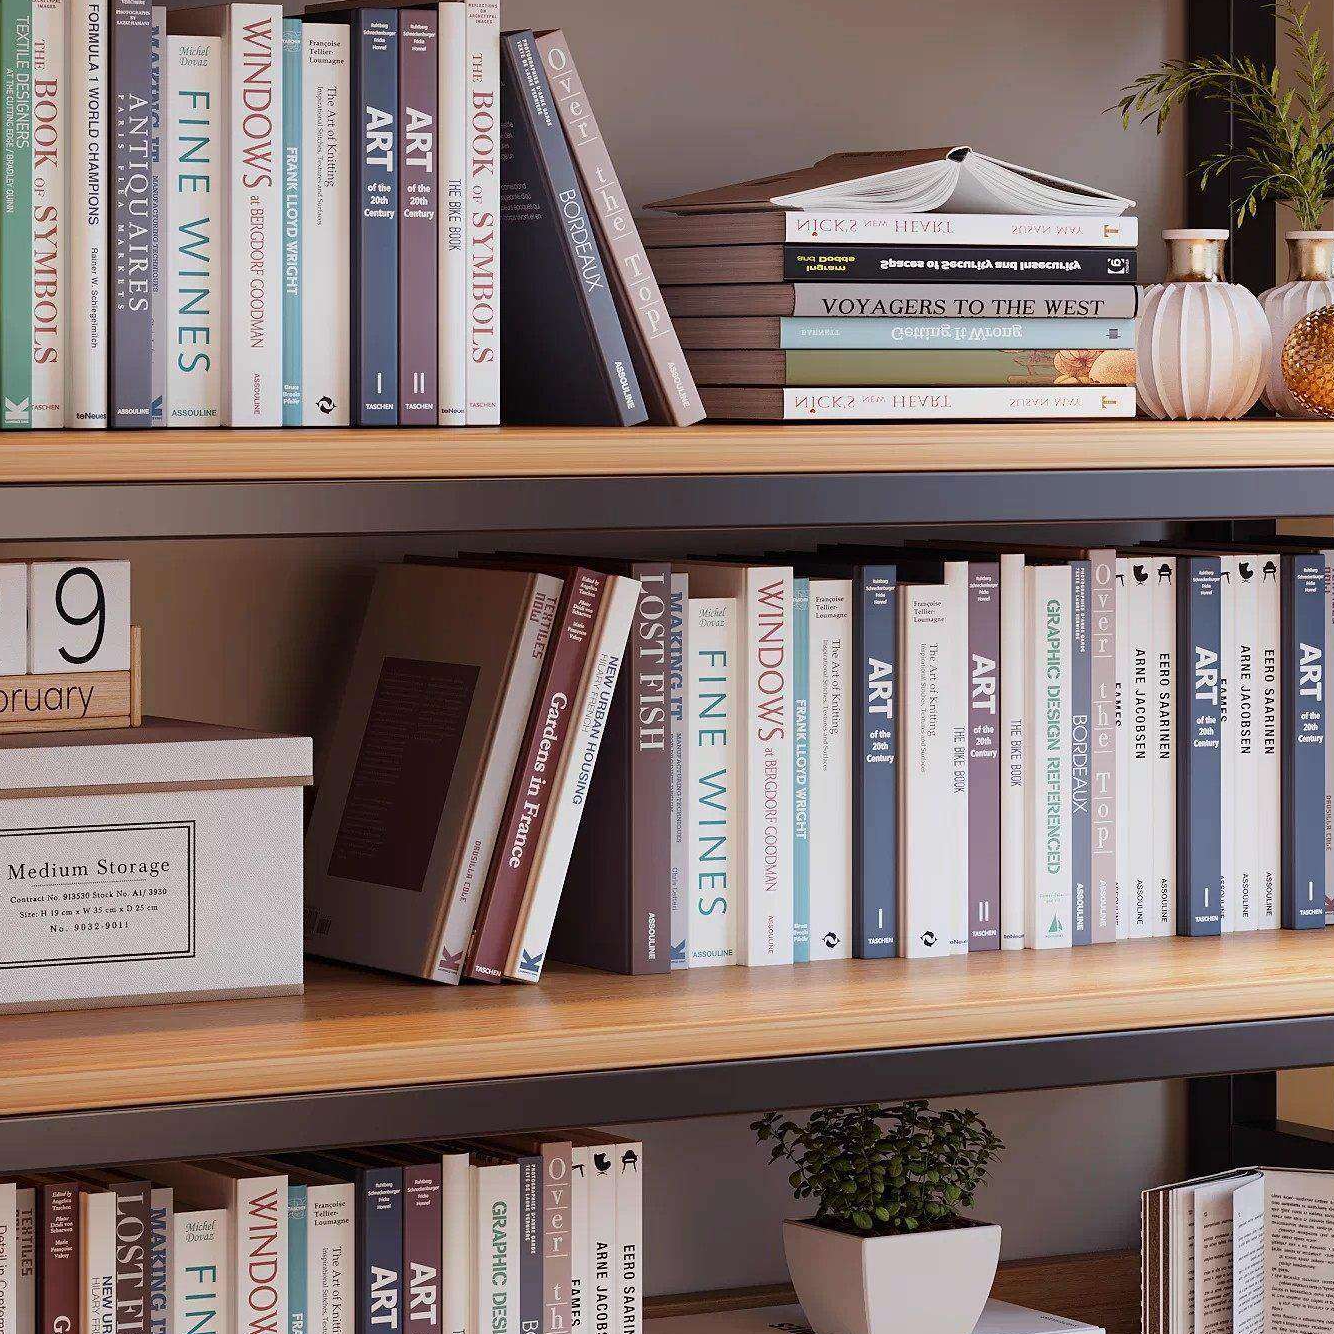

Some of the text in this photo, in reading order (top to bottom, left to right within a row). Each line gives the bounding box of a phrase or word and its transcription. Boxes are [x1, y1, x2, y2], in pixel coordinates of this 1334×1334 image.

[88, 4, 99, 73] FORMULA
[178, 45, 211, 57] Michel
[178, 57, 208, 66] Dovaz
[89, 85, 99, 143] WORLD
[366, 106, 394, 172] ART
[406, 108, 433, 172] ART
[32, 41, 59, 365] THE BOOK OF SYMBOLS
[88, 146, 100, 226] CHAMPIONS
[128, 93, 148, 313] ANTIQUAIRES
[242, 18, 272, 349] WINDOWS at BERGDORF GOODMAN
[364, 208, 395, 219] Century
[370, 196, 389, 206] 20th
[378, 183, 391, 193] the
[178, 91, 211, 373] FINE WINES
[285, 147, 298, 296] FRANK LLOYD WRIGHT
[559, 189, 604, 293] BORDEAUX
[822, 298, 1105, 316] VOYAGERS TO THE WEST
[171, 408, 217, 417] ASSOULINE
[1135, 649, 1146, 760] ARNE JACOBSEN
[1299, 642, 1322, 701] ART
[1046, 599, 1061, 876] GRAPHIC DESIGN REFERENCED
[1159, 653, 1170, 760] EERO SAARINEN
[508, 691, 568, 869] Gardens in France
[699, 650, 727, 917] FINE WINES
[8, 859, 170, 880] Medium Storage
[74, 922, 129, 931] 9032-9011
[371, 1266, 397, 1330] ART
